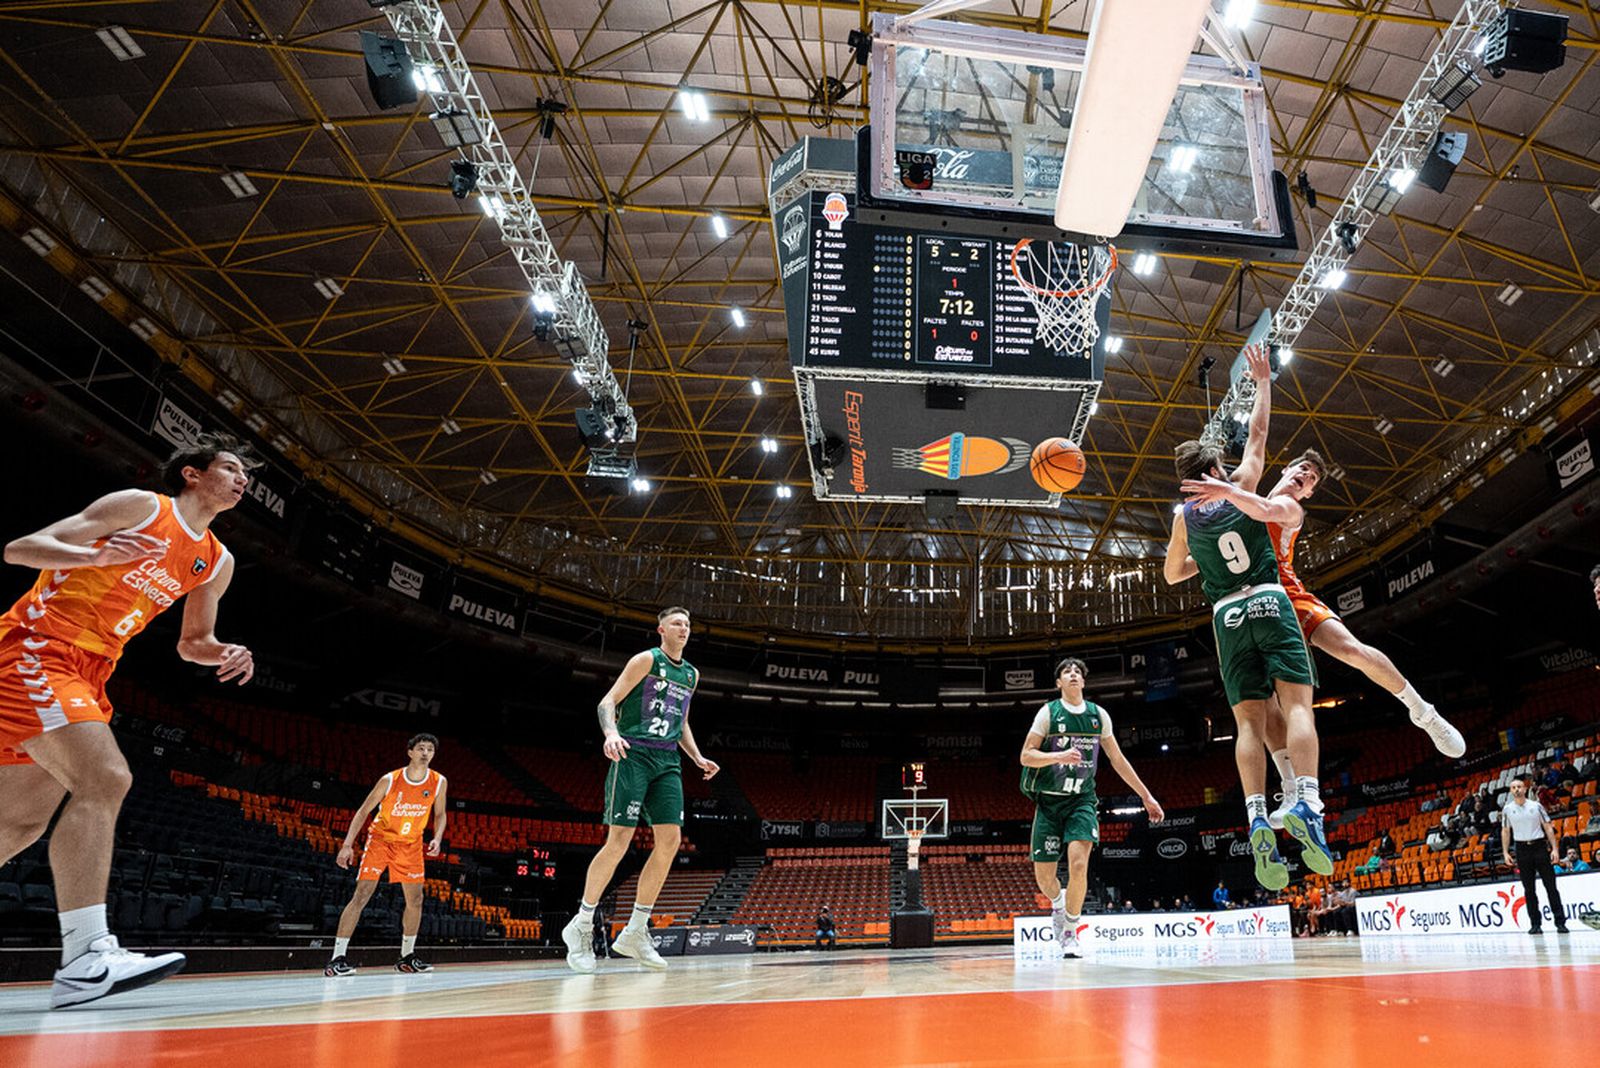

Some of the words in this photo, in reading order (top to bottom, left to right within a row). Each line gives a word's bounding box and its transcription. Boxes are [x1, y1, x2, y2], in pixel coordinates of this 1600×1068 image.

[899, 152, 934, 165] LIGA
[816, 229, 822, 238] 6
[906, 235, 913, 244] 0
[926, 238, 945, 246] LOCAL
[815, 240, 822, 248] 7
[906, 246, 912, 254] 0
[931, 246, 940, 258] 5
[970, 248, 978, 260] 2
[996, 242, 1002, 250] 2
[814, 250, 821, 259] 8
[906, 256, 912, 265] 0
[814, 260, 821, 270] 9
[906, 266, 912, 274] 5
[996, 262, 1002, 270] 5
[813, 272, 822, 280] 10
[906, 276, 912, 286] 0
[952, 278, 957, 288] 1
[996, 273, 1002, 281] 9
[812, 282, 820, 290] 11
[905, 287, 912, 296] 0
[905, 298, 912, 306] 0
[996, 294, 1004, 302] 14
[811, 304, 820, 312] 21
[905, 308, 912, 318] 0
[940, 299, 974, 316] 7:12
[810, 314, 820, 322] 22
[904, 319, 911, 328] 0
[924, 317, 948, 325] FALTES
[961, 319, 984, 327] FALTES
[904, 330, 911, 339] 0
[932, 328, 937, 339] 1
[970, 330, 978, 341] 0
[996, 336, 1004, 344] 23
[810, 336, 819, 344] 33
[904, 341, 911, 350] 0
[810, 348, 819, 356] 45
[904, 352, 910, 360] 0
[164, 404, 200, 438] PULEVA
[842, 390, 864, 448] Esperit
[1559, 445, 1588, 470] PULEVA
[850, 448, 869, 493] Taronja
[246, 474, 286, 518] LEVA
[1218, 530, 1250, 574] 9
[394, 562, 422, 584] PULEVA
[1388, 560, 1436, 598] PULEVA
[1247, 596, 1280, 608] COSTA
[1340, 590, 1362, 604] PULEVA
[449, 594, 516, 630] PULEVA
[1247, 604, 1262, 612] DEL
[1264, 604, 1280, 612] SOL
[115, 608, 143, 636] 6
[765, 664, 829, 682] PULEVA
[843, 670, 880, 684] PUL
[1006, 672, 1032, 680] PULEVA
[648, 716, 670, 737] 23
[915, 770, 923, 782] 9
[401, 822, 412, 835] 8
[770, 824, 800, 836] JYSK
[1102, 848, 1140, 857] Europcar
[1360, 909, 1391, 931] MGS
[1410, 909, 1451, 932] Seguros
[1458, 901, 1504, 928] MGS
[1539, 901, 1594, 922] euros
[1020, 926, 1054, 942] MG
[1094, 926, 1144, 941] Seguros
[1154, 922, 1198, 938] MGS
[1216, 922, 1234, 935] Seguros
[1237, 920, 1255, 936] MGS
[1266, 920, 1289, 936] Seguros
